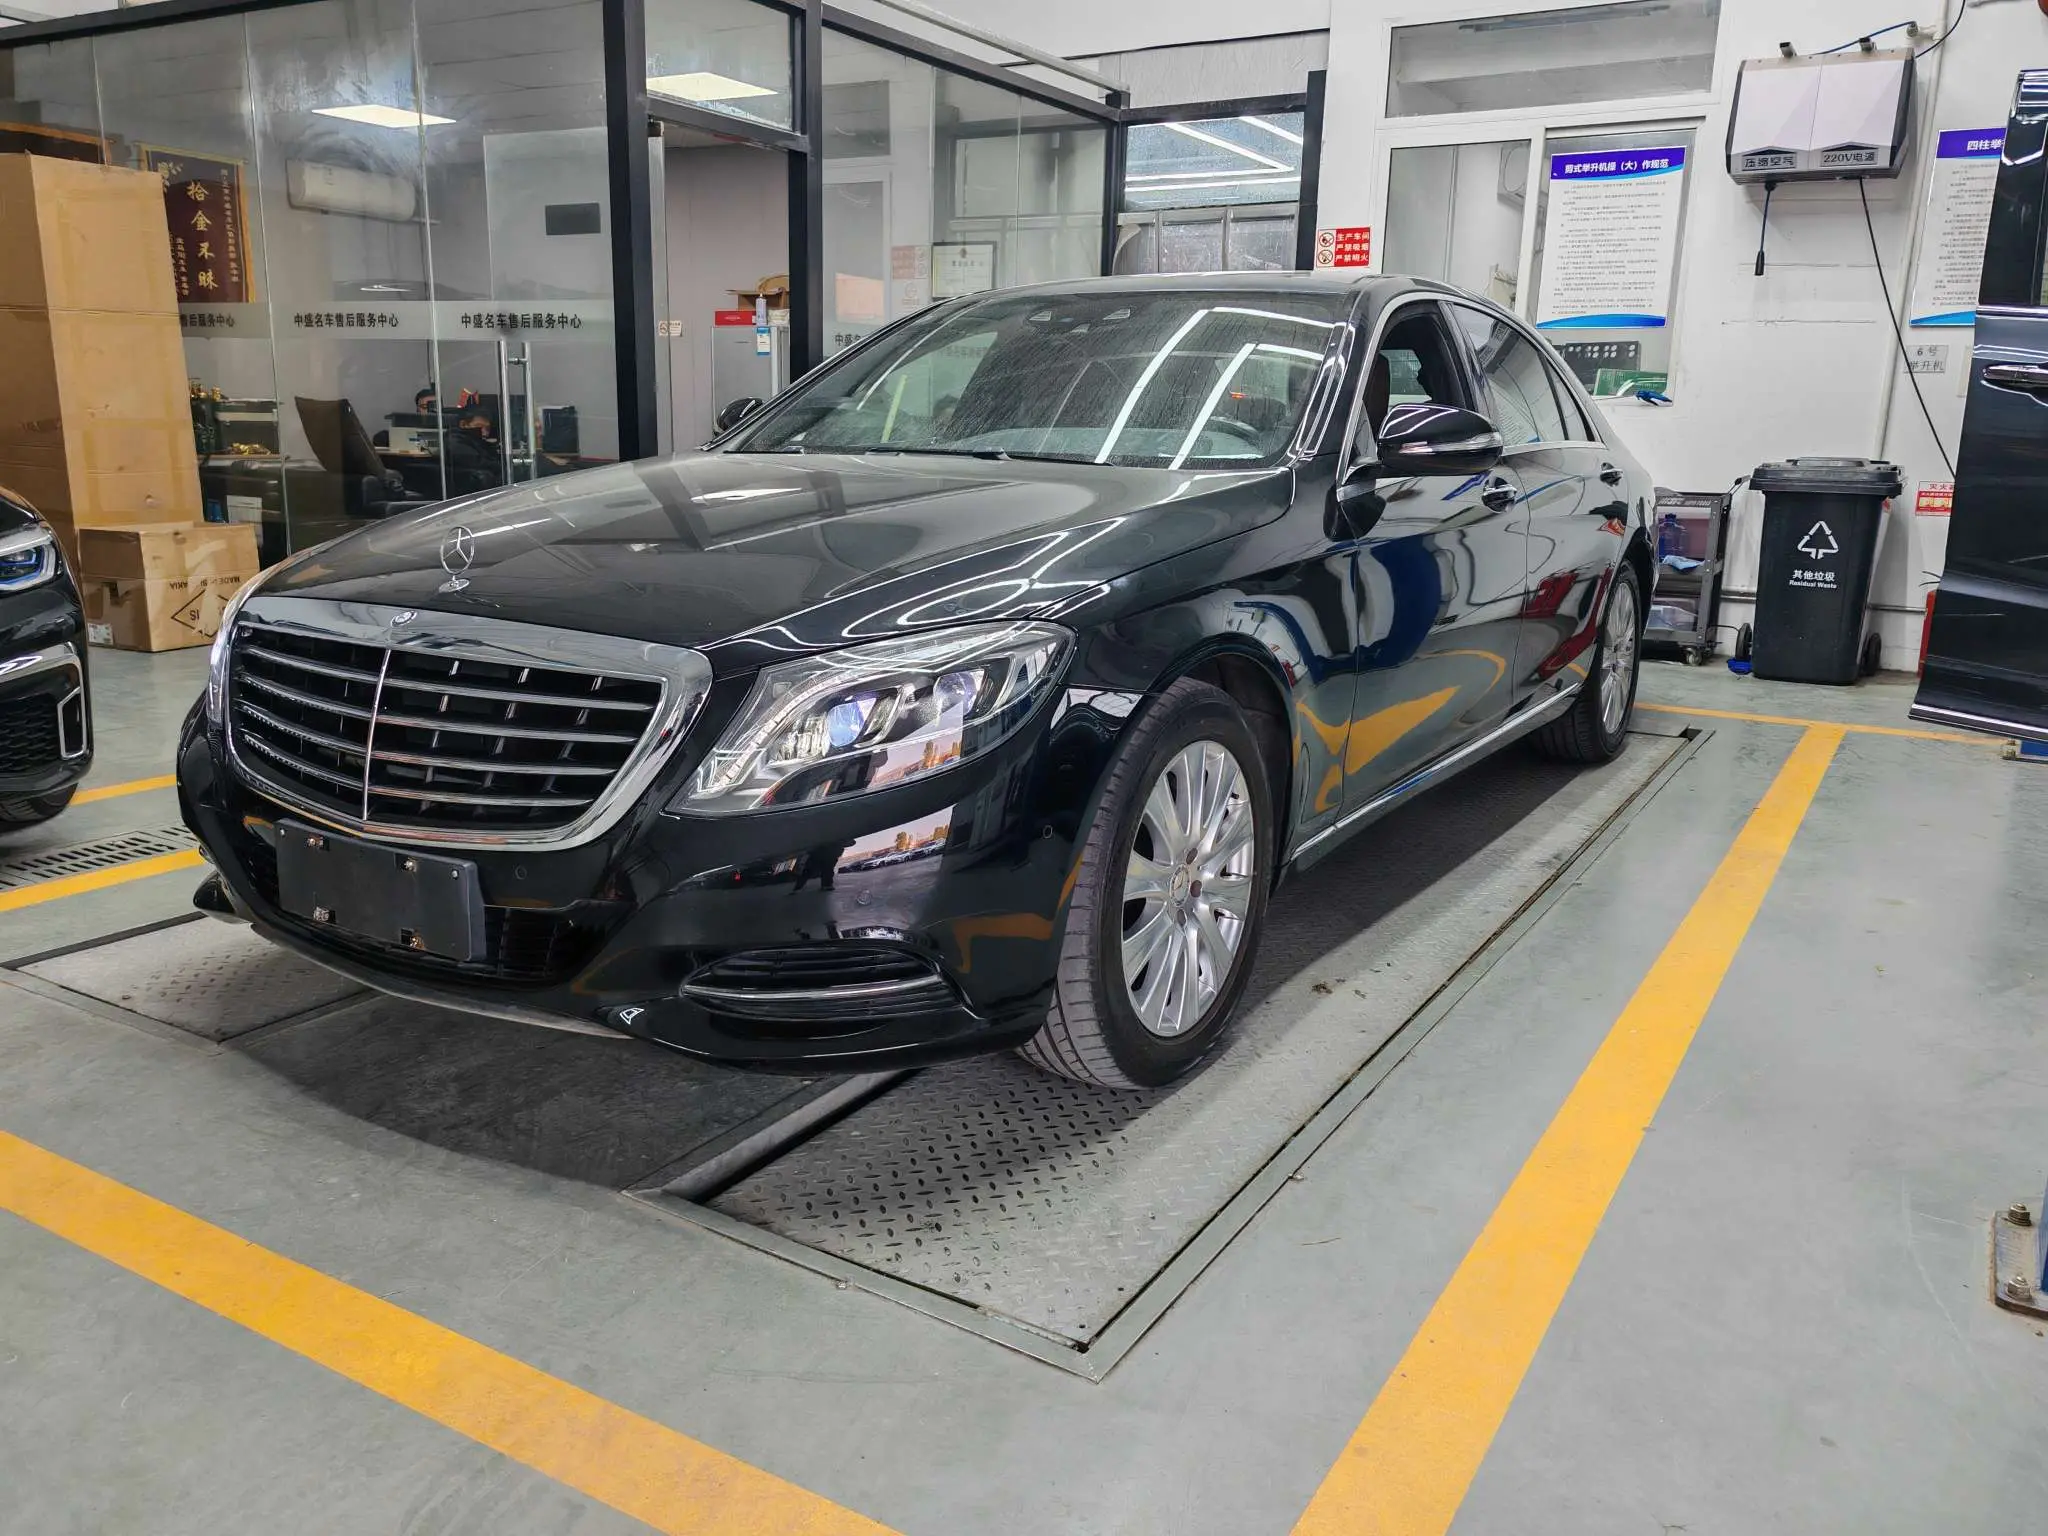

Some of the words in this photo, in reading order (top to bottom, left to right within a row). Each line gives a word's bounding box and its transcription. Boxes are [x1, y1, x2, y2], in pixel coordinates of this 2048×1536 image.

[1744, 156, 1794, 168] 压缩空气
[1823, 152, 1875, 163] 220V电源
[1336, 231, 1369, 241] 生产车间
[1336, 242, 1369, 252] 严禁吸烟
[1335, 253, 1368, 262] 严禁明火
[294, 312, 399, 328] 中盛名车售后服务中心
[461, 312, 582, 329] 中盛名车售后服务中心
[1792, 569, 1835, 581] 其他垃圾
[1789, 579, 1817, 587] Residual
[1817, 581, 1838, 589] Waste
